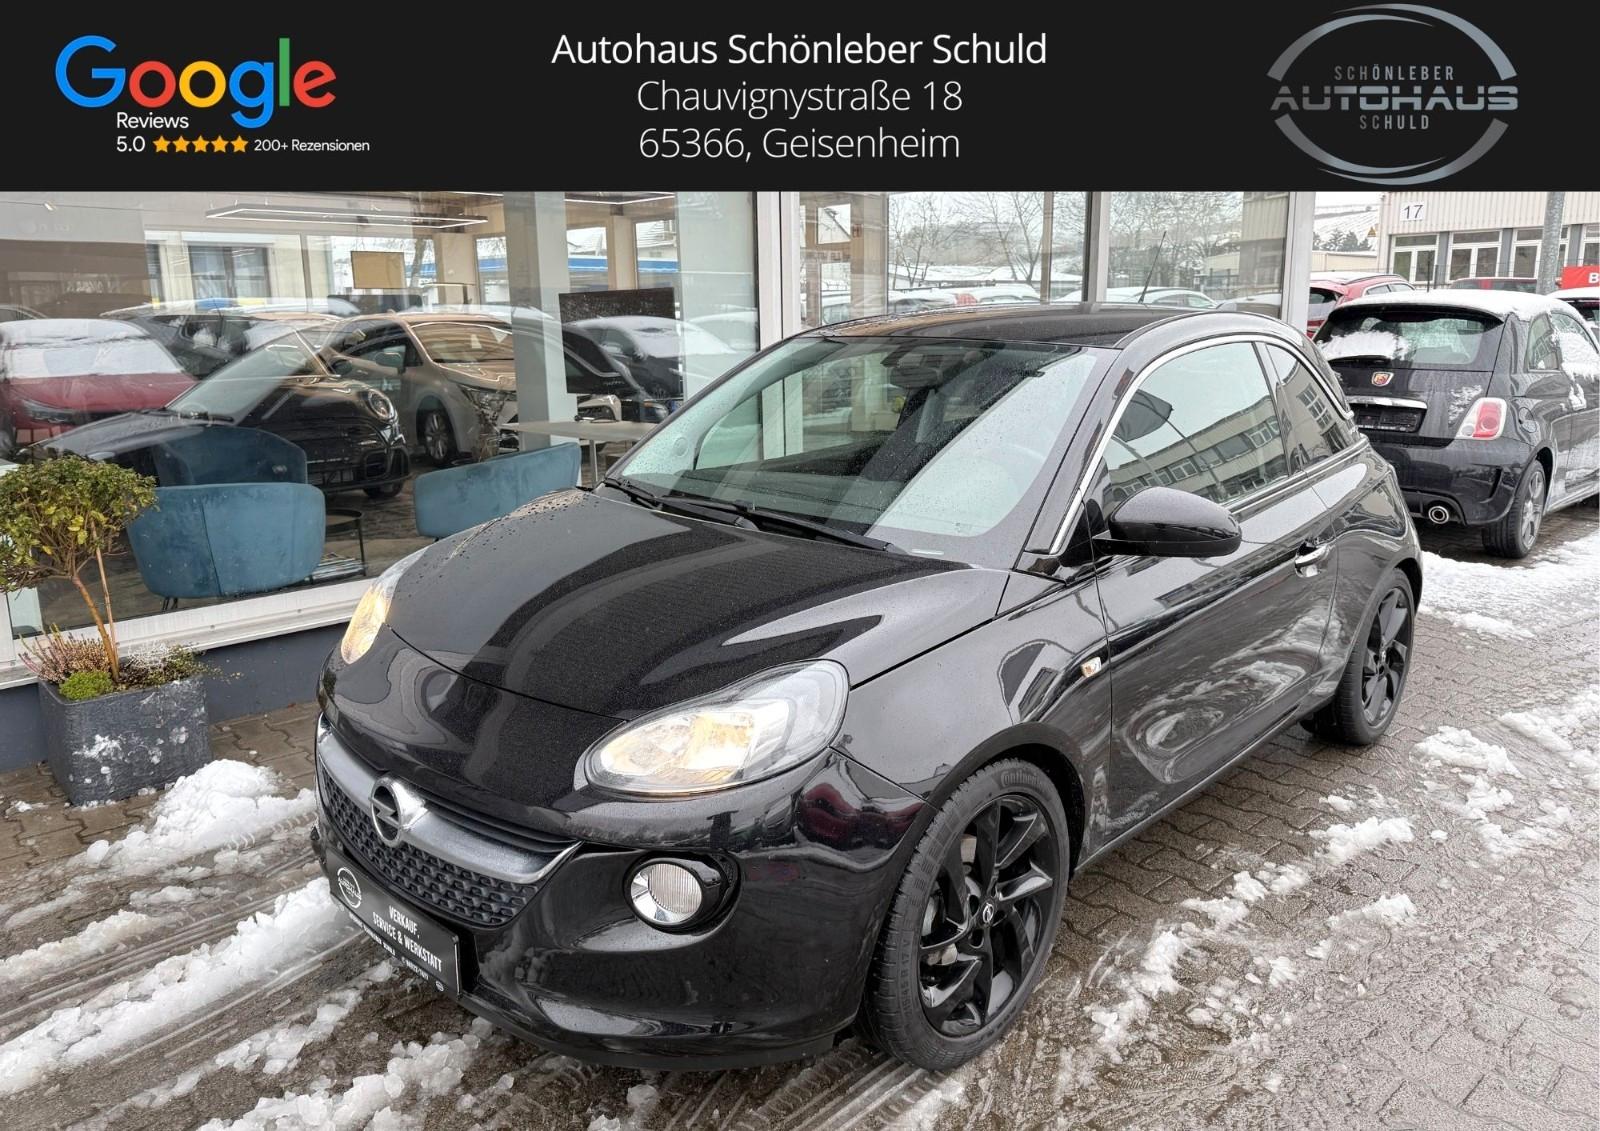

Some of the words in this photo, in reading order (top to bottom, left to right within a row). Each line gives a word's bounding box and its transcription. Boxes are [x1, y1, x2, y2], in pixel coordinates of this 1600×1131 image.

[1404, 205, 1423, 219] 17
[372, 911, 397, 941] SERVICE
[403, 934, 442, 972] WERKSTATT
